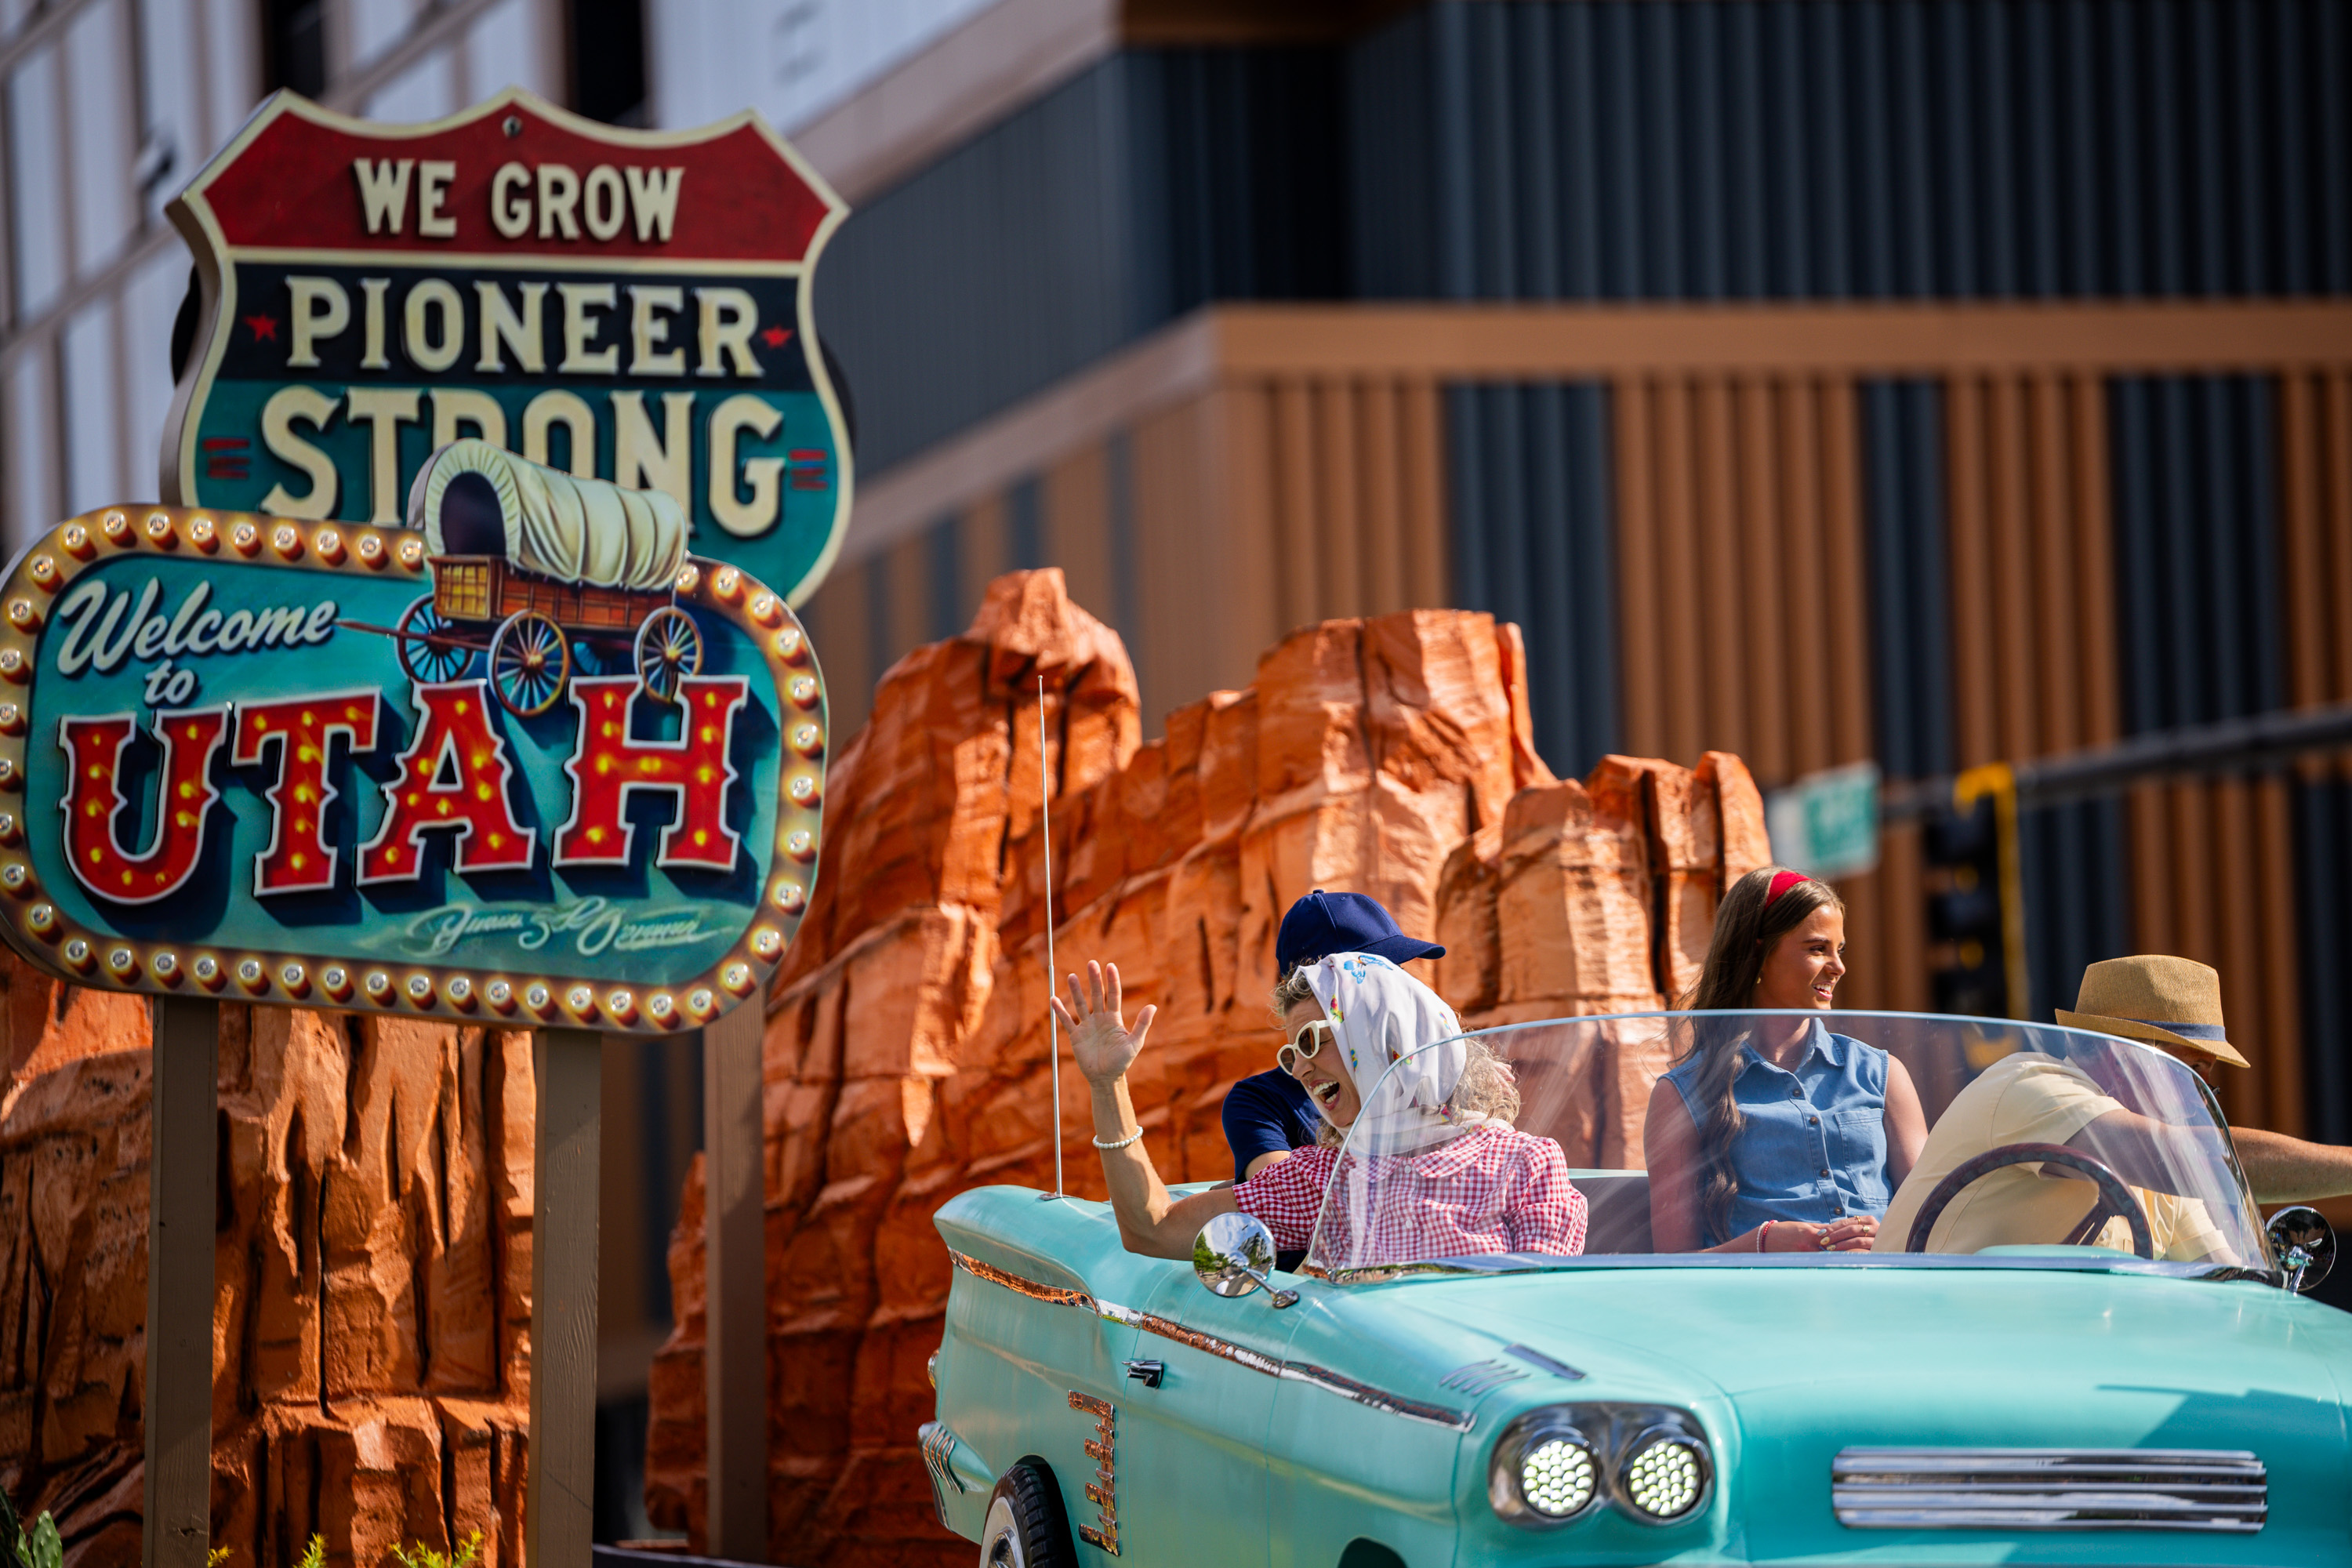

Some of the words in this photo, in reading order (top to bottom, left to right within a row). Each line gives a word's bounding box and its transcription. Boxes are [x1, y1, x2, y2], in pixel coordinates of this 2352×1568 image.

[354, 159, 457, 238] WE
[491, 162, 685, 242] GROW
[285, 275, 764, 376] PIONEER
[57, 576, 336, 675] Welcome
[144, 659, 194, 704] to
[60, 675, 750, 904] UTAH
